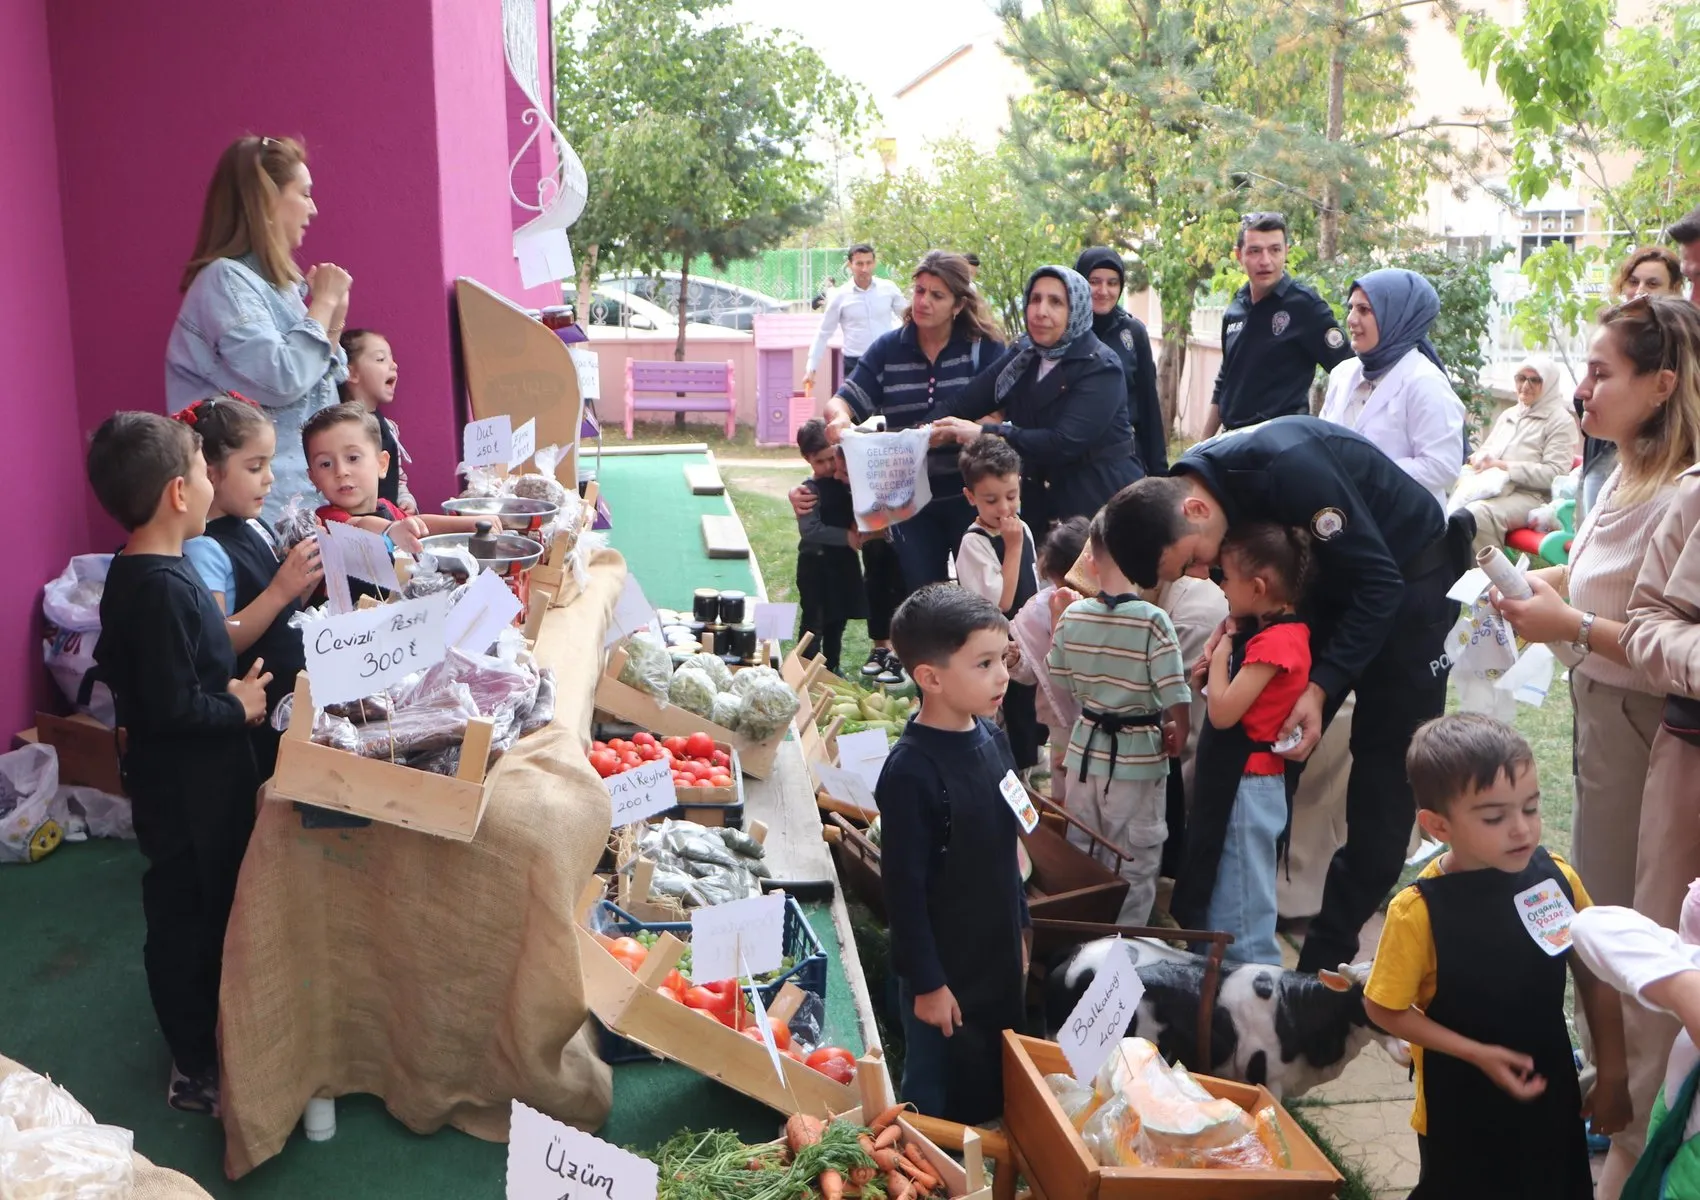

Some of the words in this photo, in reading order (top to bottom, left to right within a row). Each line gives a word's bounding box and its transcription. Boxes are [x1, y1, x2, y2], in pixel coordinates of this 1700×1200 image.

[315, 628, 376, 655] Cevizli
[359, 647, 404, 678] 300
[617, 797, 642, 813] 200
[1527, 900, 1565, 922] Organik
[1535, 909, 1565, 929] Pazar
[545, 1135, 614, 1199] Üzüm
